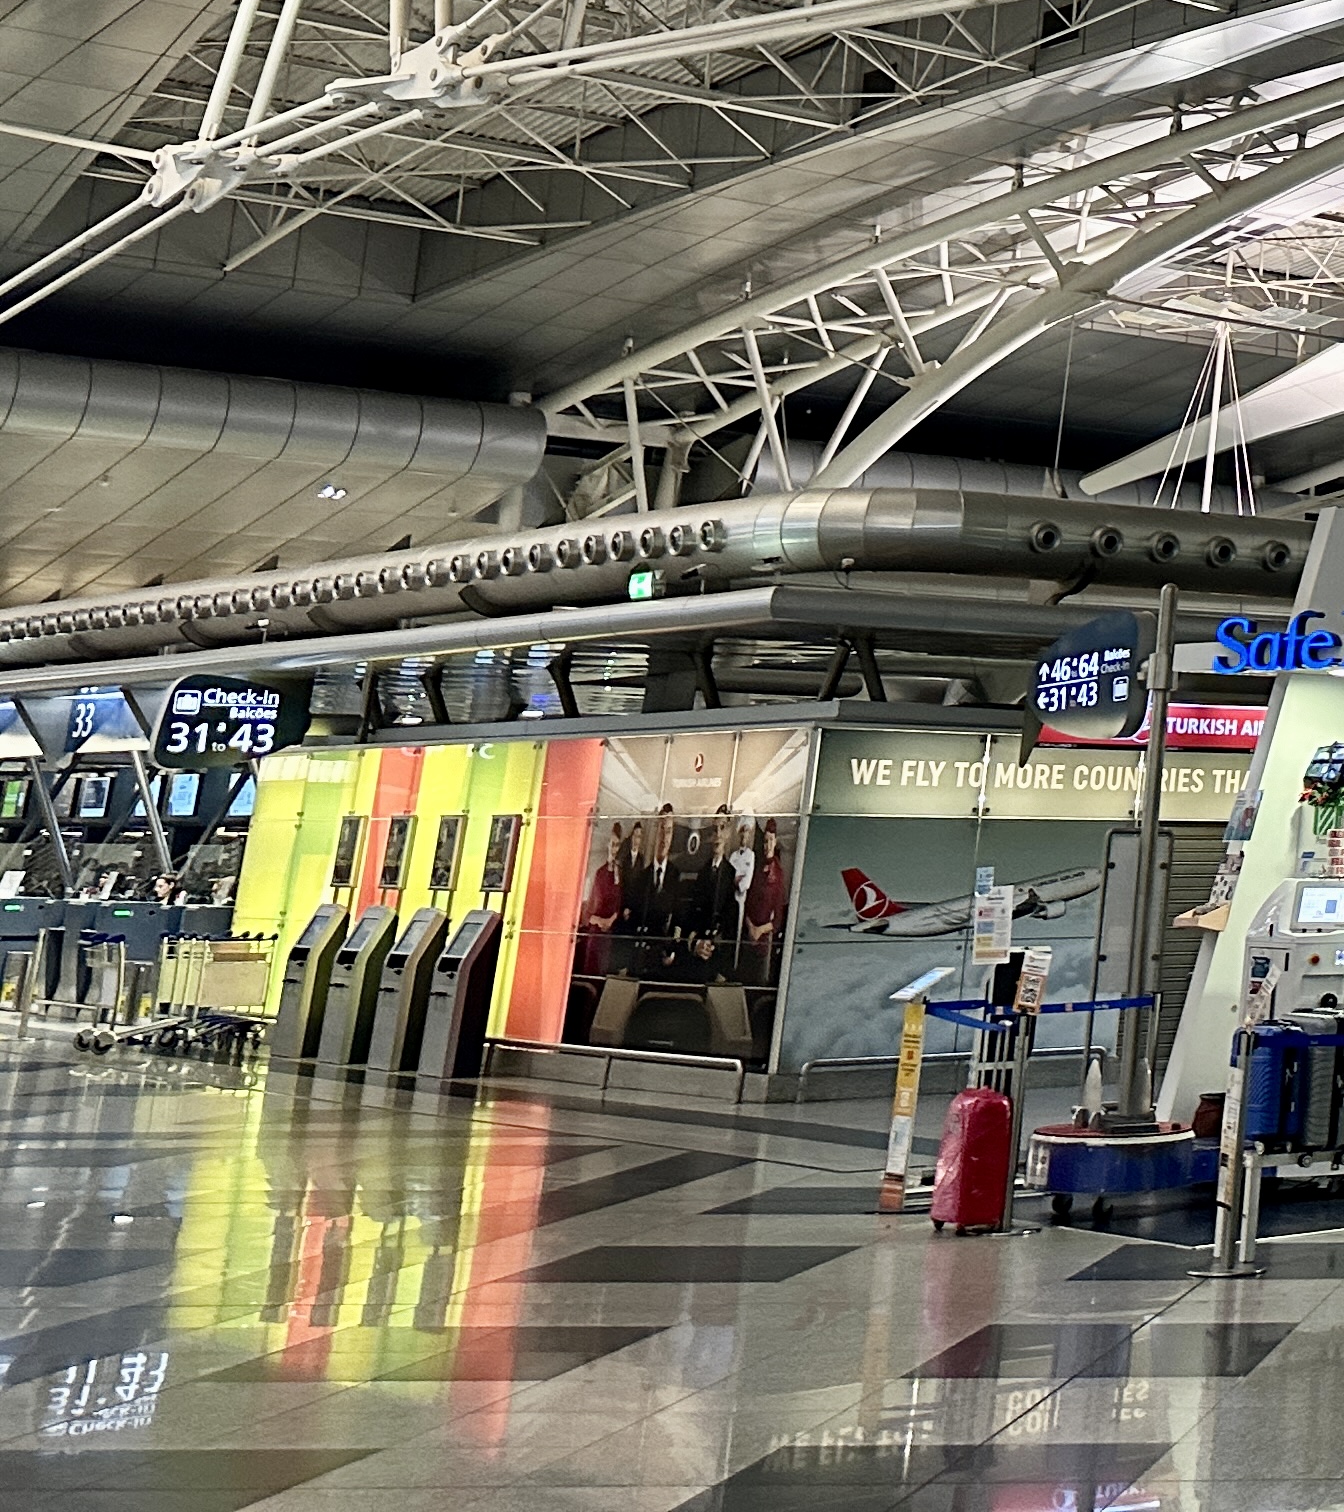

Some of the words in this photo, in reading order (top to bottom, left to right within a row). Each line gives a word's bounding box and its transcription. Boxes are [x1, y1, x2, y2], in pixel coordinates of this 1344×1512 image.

[1213, 610, 1341, 675] Safe
[1051, 657, 1071, 681] 46
[1079, 652, 1099, 678] 64
[1048, 687, 1067, 712] 31
[1077, 682, 1098, 706] 43
[72, 703, 96, 738] 33
[1166, 712, 1239, 736] TURKISH
[166, 722, 208, 753] 31
[229, 723, 275, 752] 43
[850, 759, 892, 785] WE
[900, 760, 946, 786] FLY
[954, 761, 985, 788] TO
[995, 763, 1065, 790] MORE
